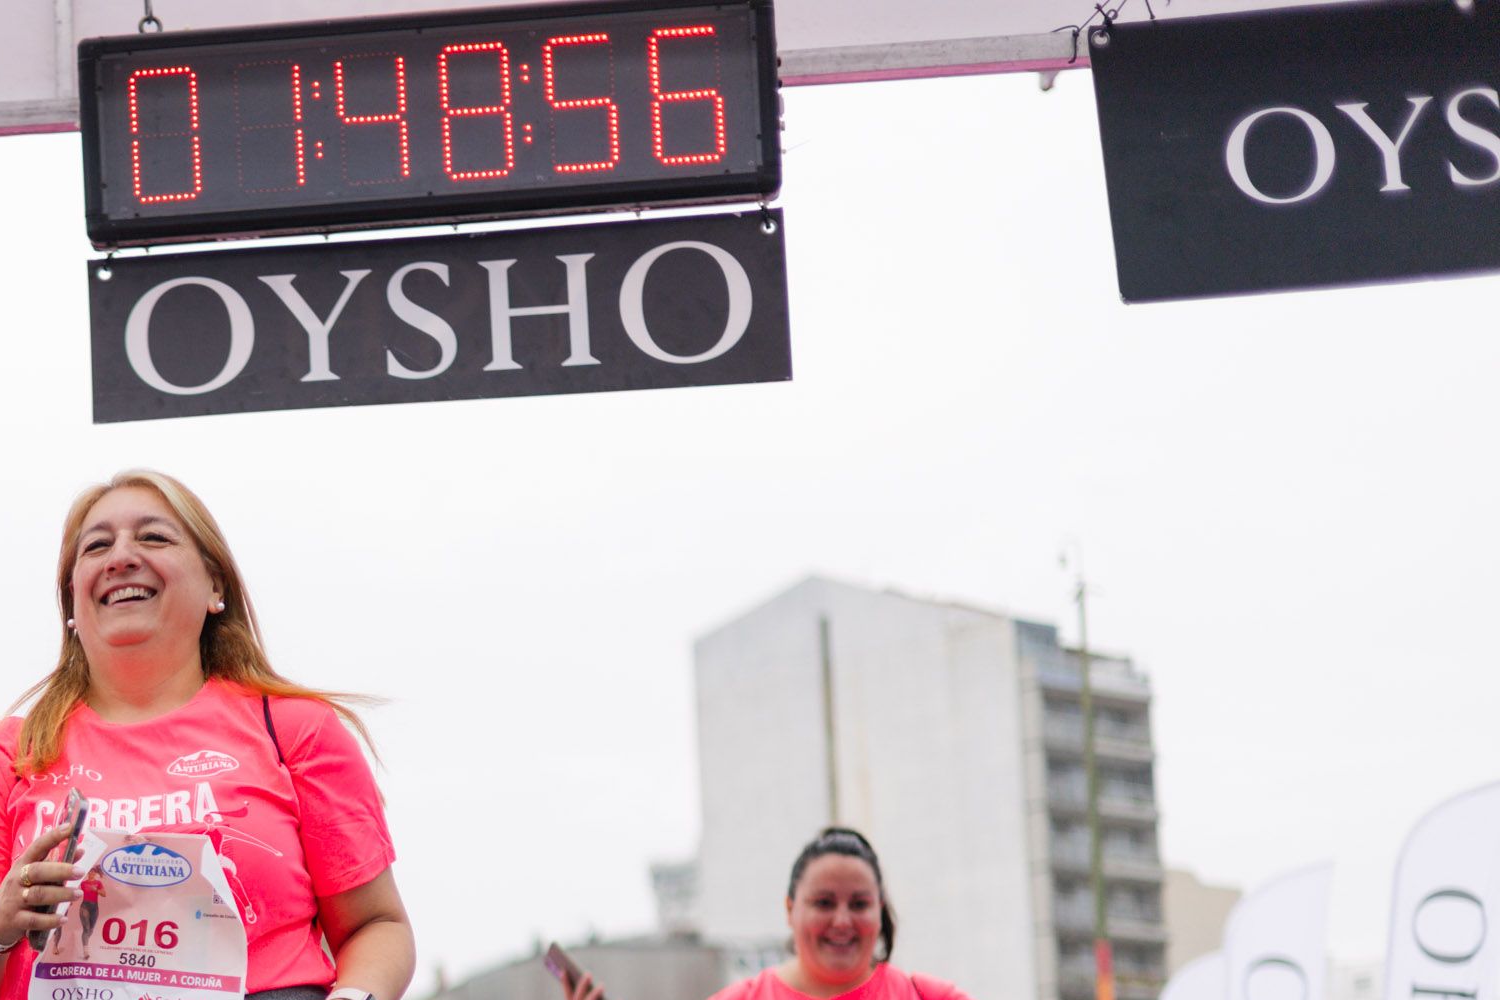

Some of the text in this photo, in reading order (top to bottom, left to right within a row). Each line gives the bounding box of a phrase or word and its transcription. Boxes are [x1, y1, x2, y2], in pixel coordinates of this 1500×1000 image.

[128, 25, 727, 205] 01:48:56
[124, 240, 754, 396] OYSHO
[173, 761, 234, 773] ASTURIANA
[108, 857, 185, 878] ASTURIANA
[102, 918, 179, 949] 016
[119, 953, 156, 968] 5840
[50, 965, 222, 988] CARRERA DE LA MUJER A CORUÑA
[52, 987, 113, 1000] OYSHO
